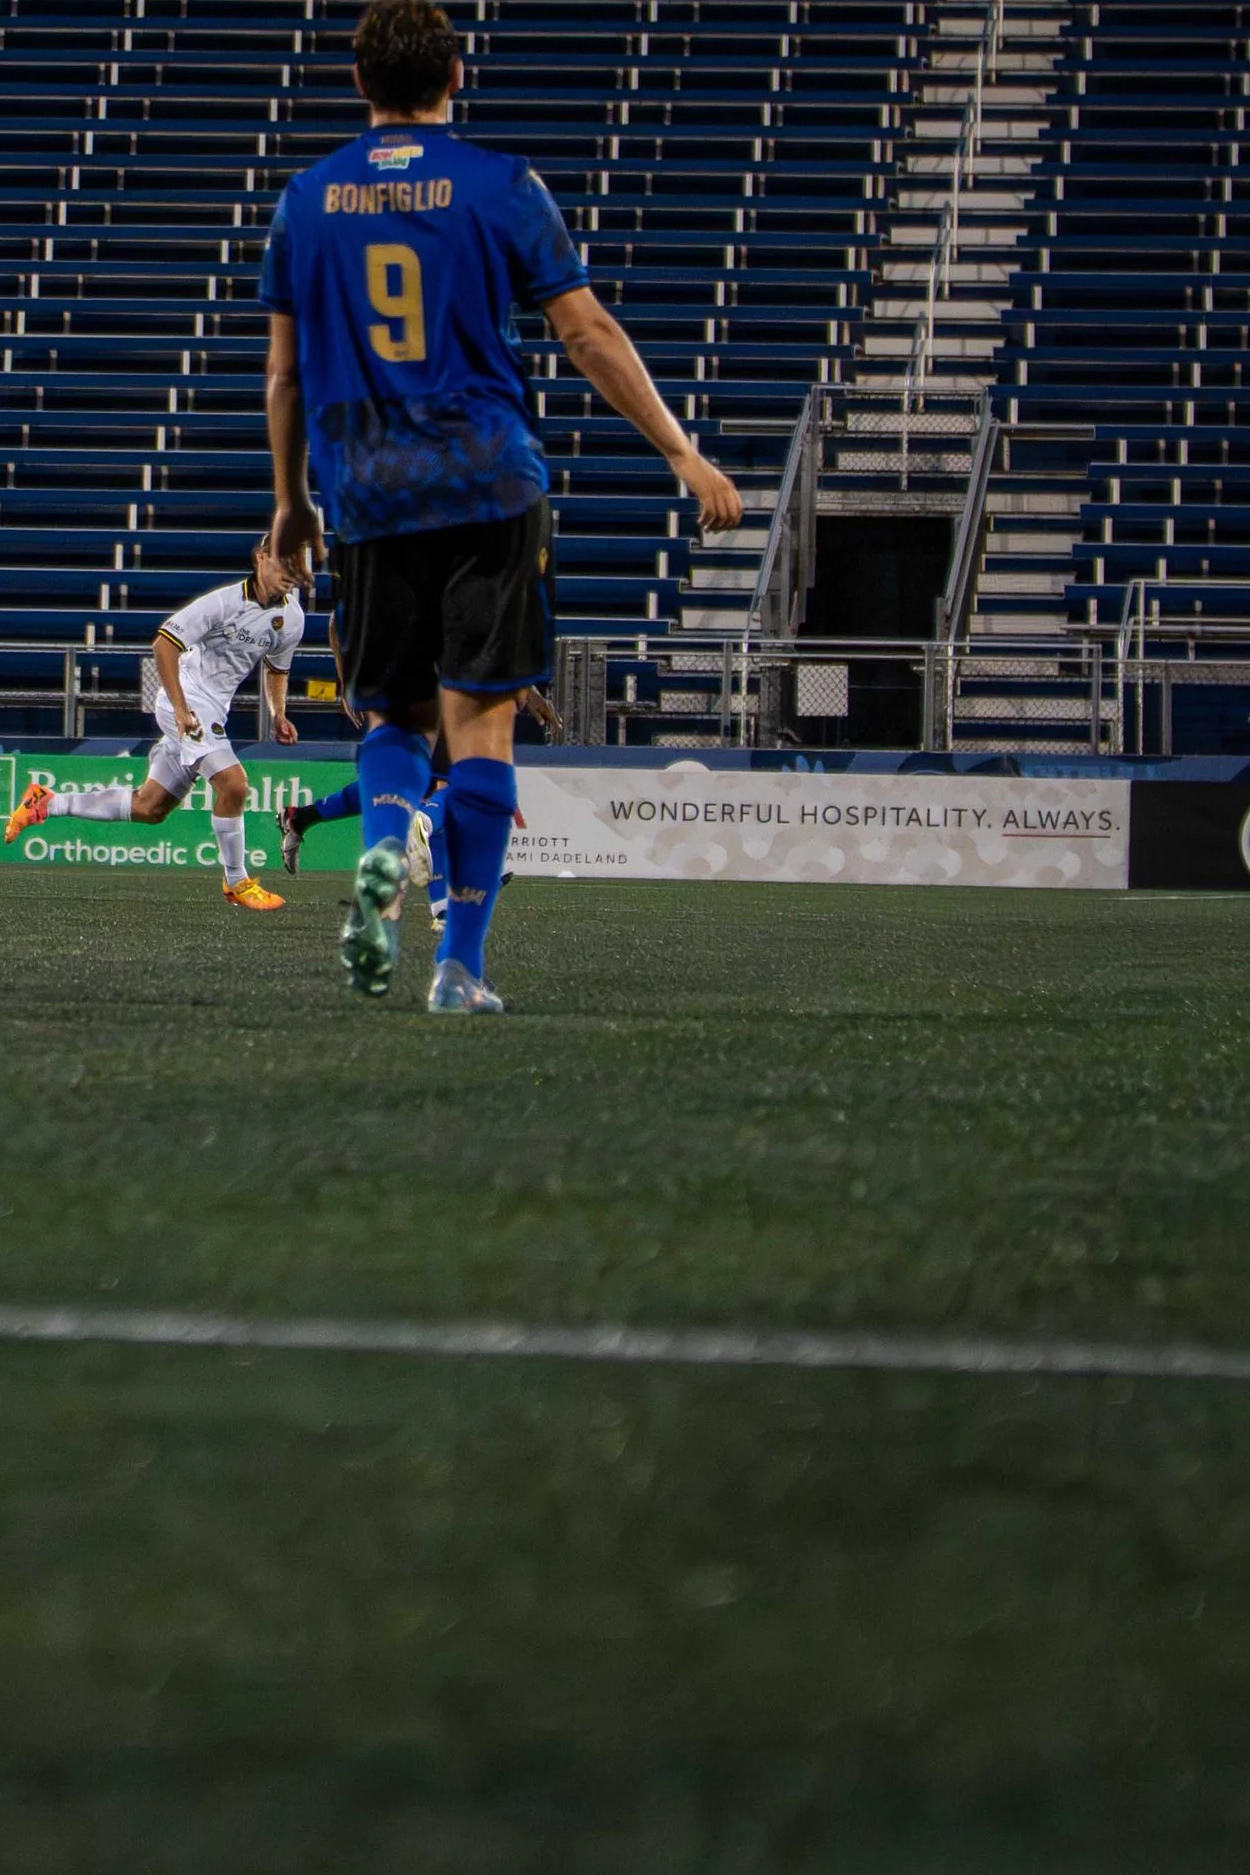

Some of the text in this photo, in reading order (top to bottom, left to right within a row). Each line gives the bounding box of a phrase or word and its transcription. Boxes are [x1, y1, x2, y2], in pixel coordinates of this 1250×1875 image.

[325, 178, 452, 214] BONFIGLIO
[365, 243, 427, 363] 9
[180, 775, 313, 813] Halth
[610, 800, 1121, 831] WONDERFUL HOSPITALITY. ALWAYS.
[24, 837, 188, 866] Orthopedic
[511, 836, 570, 848] RRIOTT
[506, 852, 628, 865] AMI DADELAND
